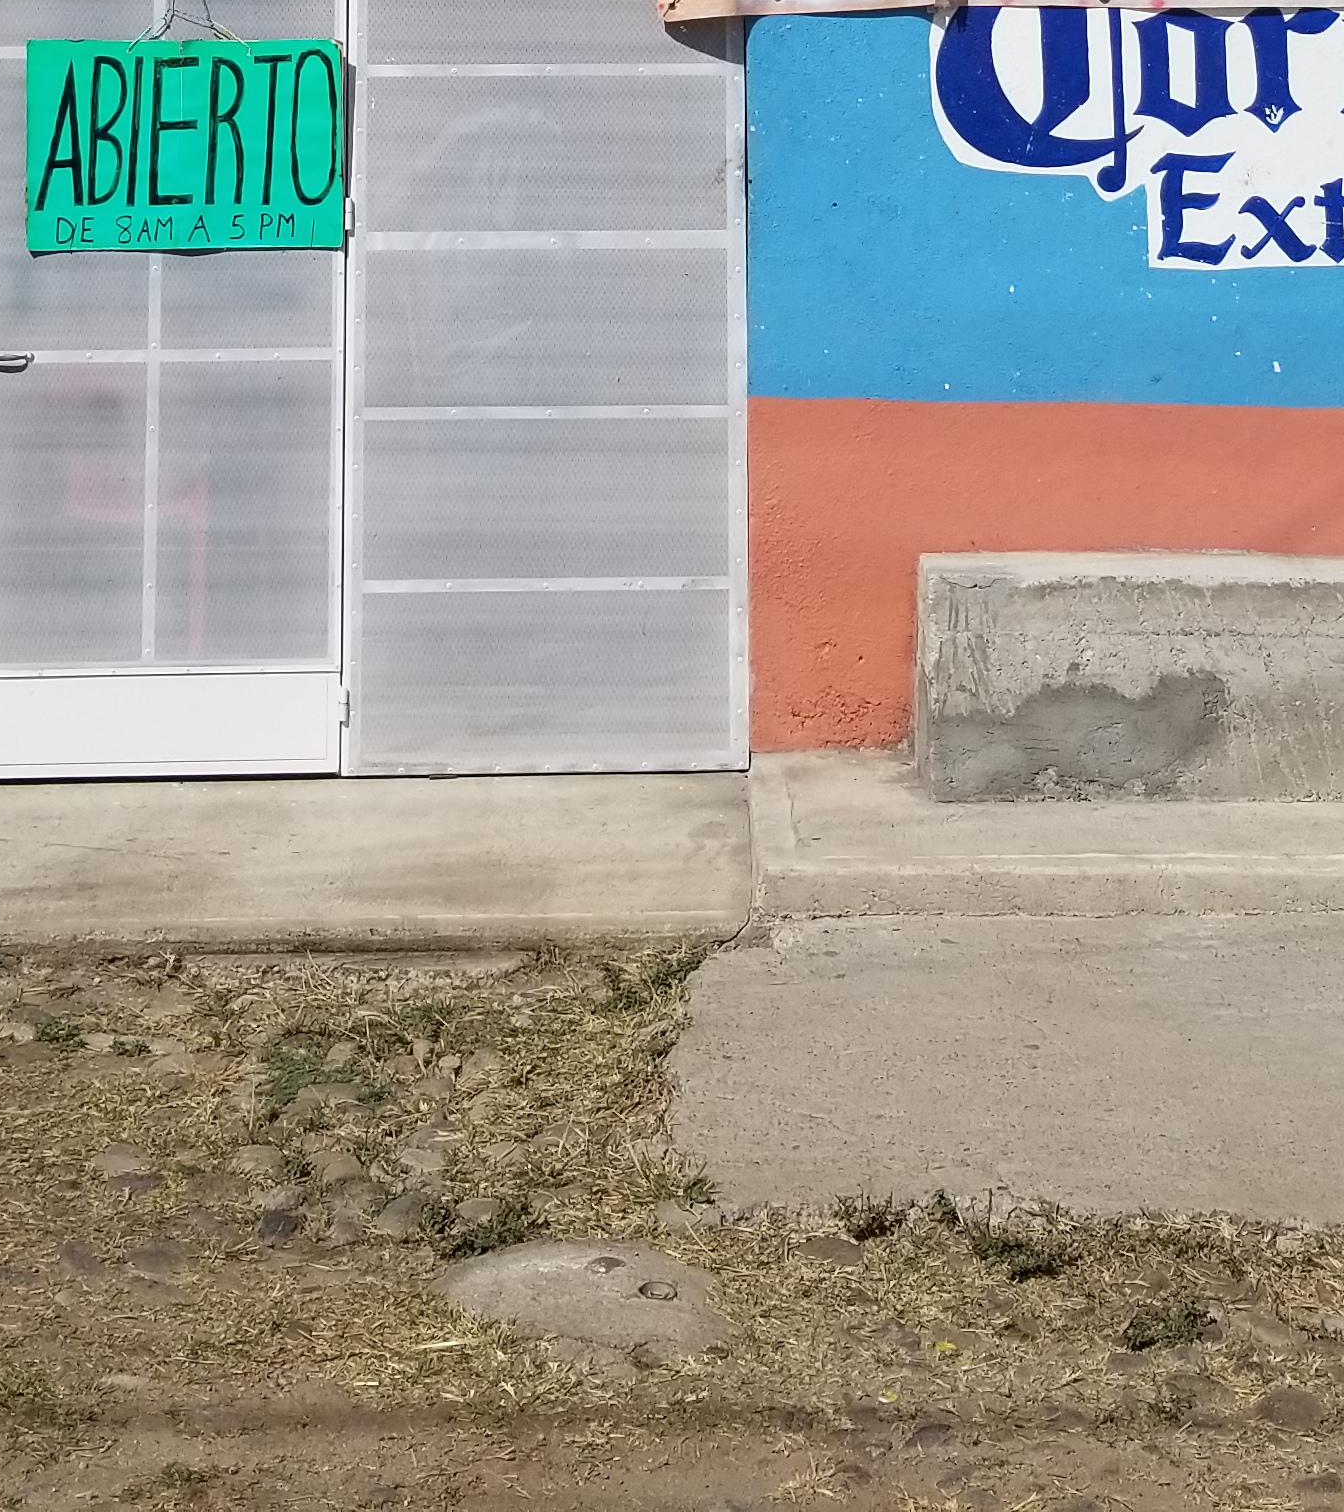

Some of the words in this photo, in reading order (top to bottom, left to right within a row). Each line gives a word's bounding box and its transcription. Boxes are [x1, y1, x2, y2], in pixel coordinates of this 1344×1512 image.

[33, 48, 337, 212] ABIERTO
[56, 216, 95, 244] DE
[115, 214, 173, 244] 8AM
[187, 214, 211, 243] A
